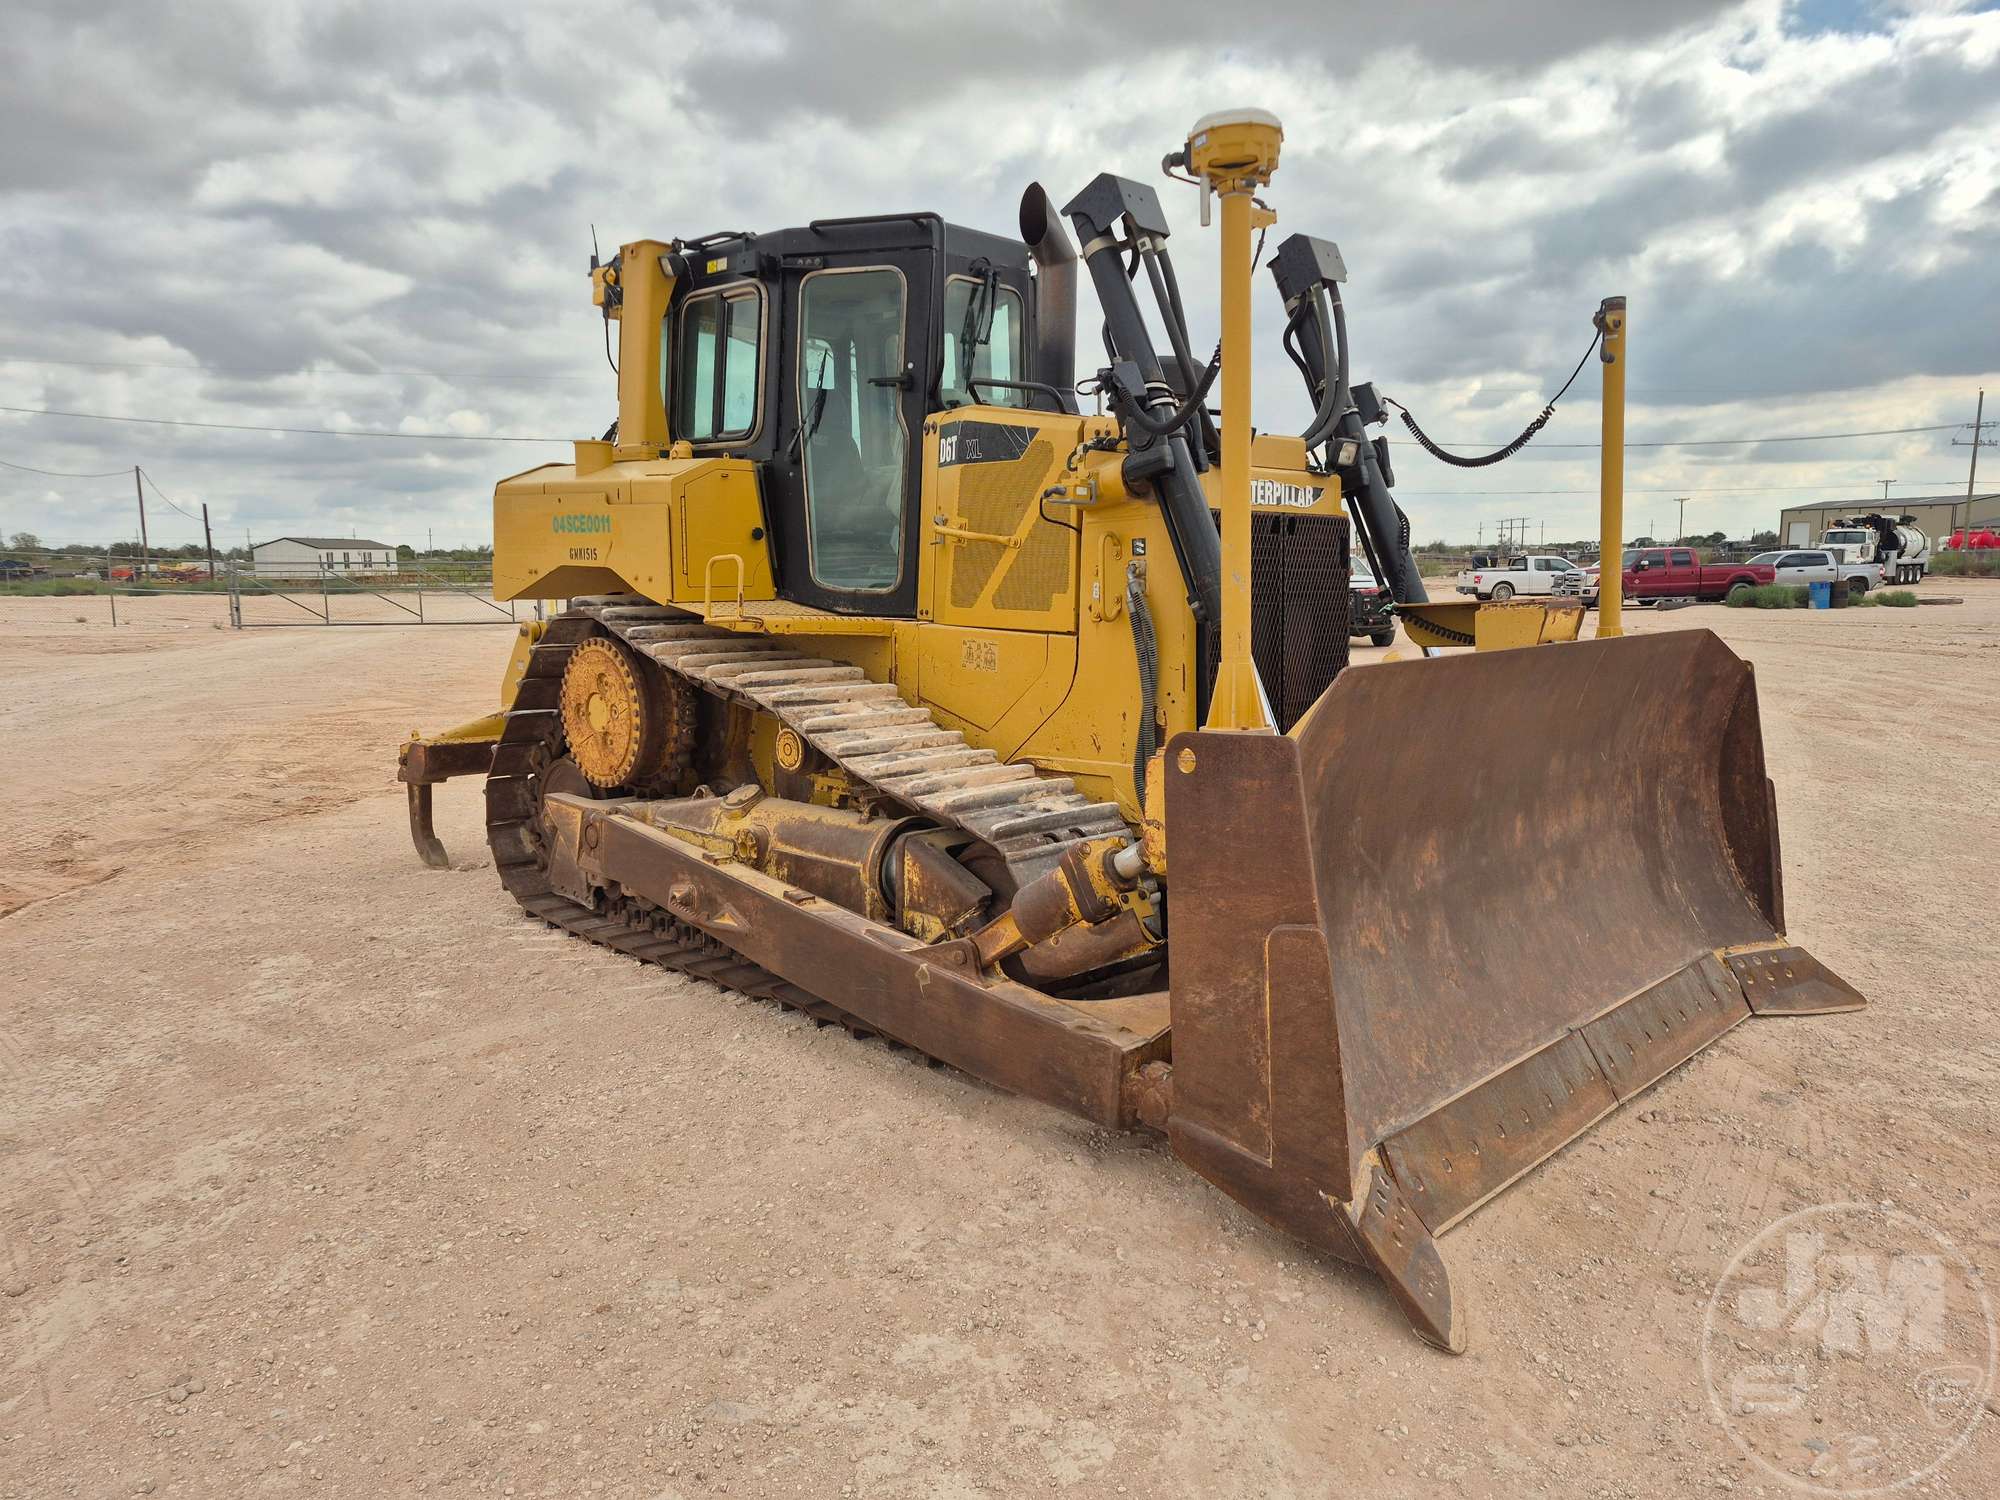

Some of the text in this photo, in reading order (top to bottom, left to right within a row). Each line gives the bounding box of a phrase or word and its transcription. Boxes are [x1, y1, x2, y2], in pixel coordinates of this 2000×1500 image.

[940, 435, 982, 463] D6T XL
[1250, 479, 1313, 507] TERPILLAR
